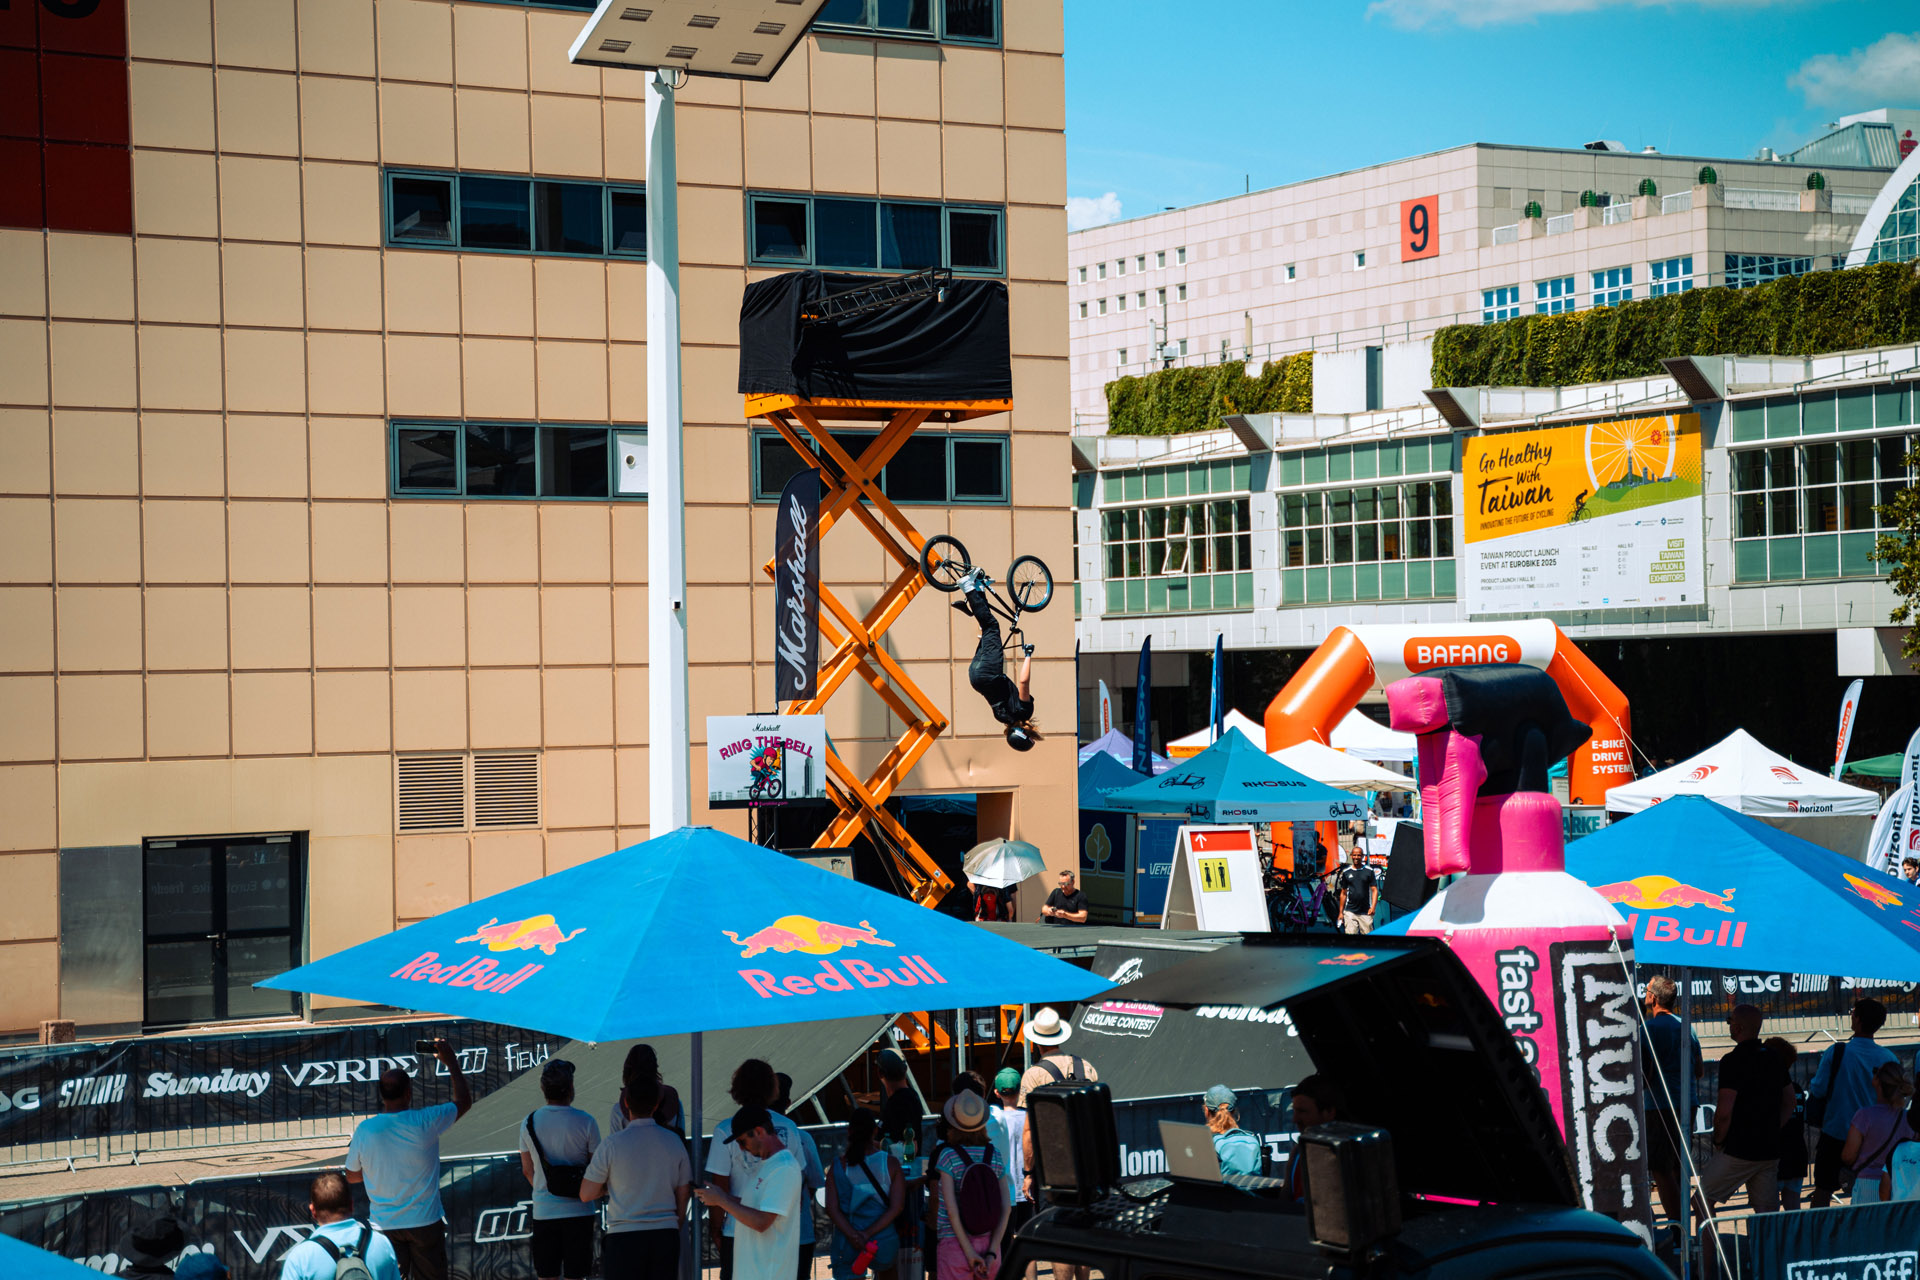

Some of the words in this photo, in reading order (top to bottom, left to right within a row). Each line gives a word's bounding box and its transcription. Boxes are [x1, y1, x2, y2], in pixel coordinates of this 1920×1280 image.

[1409, 203, 1429, 252] 9
[1479, 452, 1496, 474] Go
[1498, 441, 1552, 469] Healthy
[1516, 462, 1542, 486] With
[1477, 478, 1554, 516] Taiwan
[1505, 516, 1513, 526] THE
[1513, 513, 1530, 524] FUTURE
[1530, 511, 1536, 520] OF
[1536, 508, 1554, 519] CYCLING
[1480, 552, 1503, 560] TAIWAN
[1505, 550, 1532, 558] PRODUCT
[1534, 548, 1559, 557] LAUNCH
[1668, 540, 1683, 548] VISIT
[1480, 562, 1499, 570] EVENT
[1509, 560, 1540, 568] EUROBIKE
[1661, 551, 1684, 560] TAIWAN
[1652, 563, 1677, 572] PAVILION
[779, 494, 808, 691] Marshall
[1418, 643, 1508, 664] BAFANG
[752, 722, 781, 732] Marshall
[719, 738, 752, 760] RING
[755, 736, 781, 748] THE
[784, 738, 813, 758] BELL
[1592, 740, 1624, 749] E-BIKE
[1592, 752, 1623, 761] DRIVE
[1800, 803, 1833, 813] horizont
[1885, 811, 1903, 881] orizont
[1644, 915, 1747, 948] Bull
[390, 951, 455, 986] Red
[447, 957, 543, 995] Bull
[738, 962, 838, 999] Red
[836, 955, 947, 988] Bull
[1499, 950, 1538, 1029] fast
[1084, 1013, 1118, 1027] SKYLINE
[1117, 1017, 1156, 1031] CONTEST
[143, 1068, 271, 1098] Sunday
